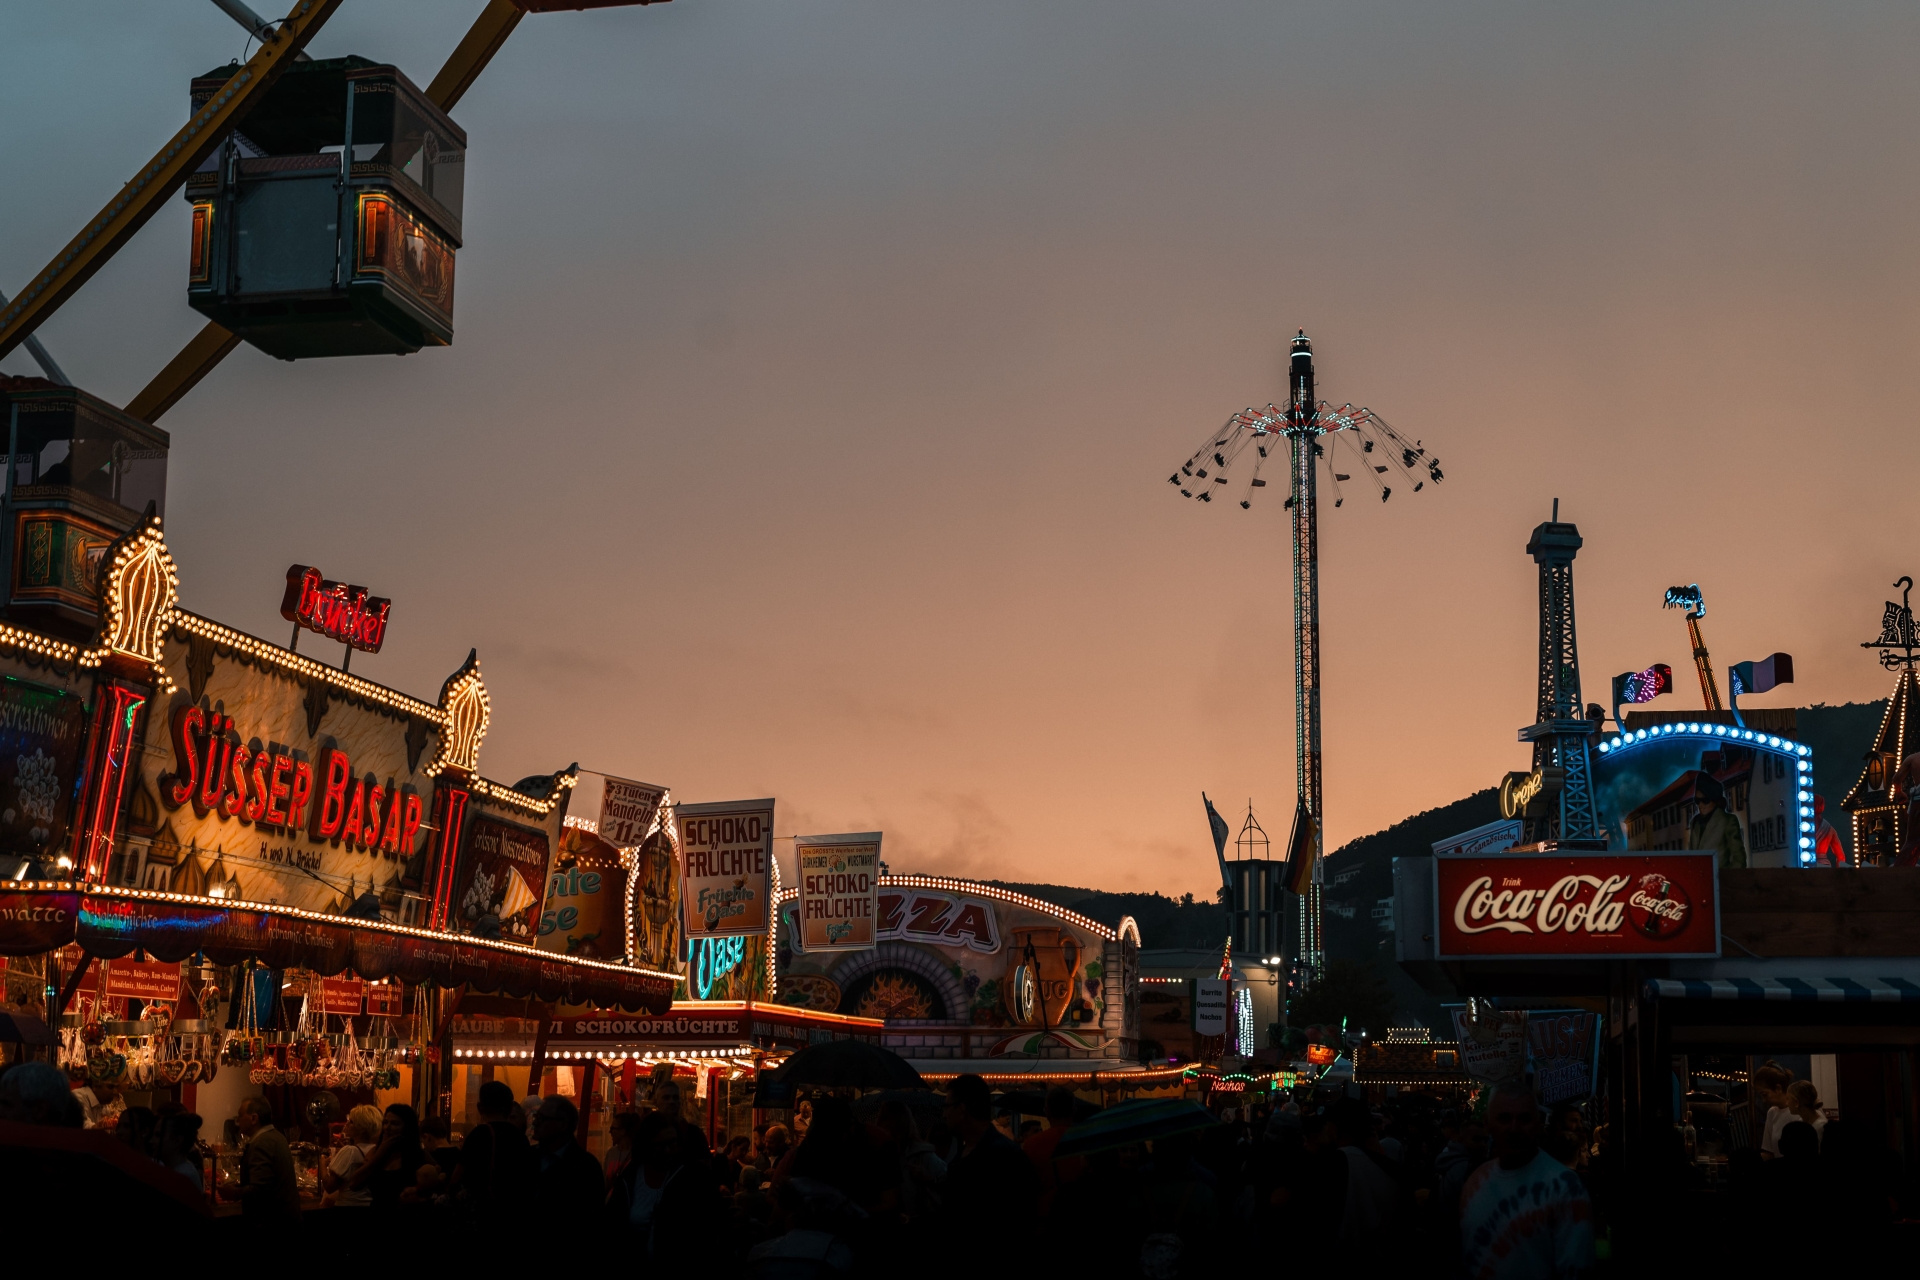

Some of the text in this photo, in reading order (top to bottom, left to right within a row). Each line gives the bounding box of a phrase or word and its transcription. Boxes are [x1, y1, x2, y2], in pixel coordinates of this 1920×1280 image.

[172, 705, 424, 857] SÜSSER BASAR
[615, 785, 651, 801] 3 Tüten
[605, 798, 654, 824] Mandeln
[685, 816, 771, 846] SCHOKO-
[686, 842, 764, 877] FRÜCHTE
[802, 855, 875, 869] DÜRKHEIMER WURSTMARKT
[806, 873, 877, 895] SCHOKO-
[1501, 877, 1522, 887] Trink
[697, 885, 755, 914] Früchte
[806, 892, 872, 919] FRÜCHTE
[1454, 874, 1630, 934] Coca-Cola
[1629, 890, 1689, 921] Coca-Cola
[705, 903, 745, 923] Oase
[877, 894, 994, 944] ZZA
[82, 898, 157, 937] Schokofrüchte
[414, 948, 426, 960] aus
[428, 947, 449, 970] eigener
[540, 961, 561, 986] frisches
[1196, 1001, 1227, 1009] Quesadilla
[1201, 989, 1223, 997] Burrito
[453, 1020, 505, 1035] RAUBE
[575, 1018, 739, 1036] SCHOKOFRÜCHTE
[1200, 1013, 1222, 1021] Nachos
[1497, 1030, 1523, 1040] uplo
[1527, 1013, 1595, 1061] LUSH
[1468, 1049, 1507, 1063] nutella
[1211, 1080, 1246, 1092] Nachos
[1538, 1060, 1589, 1089] PALMEN-
[1542, 1075, 1590, 1106] BECHER
